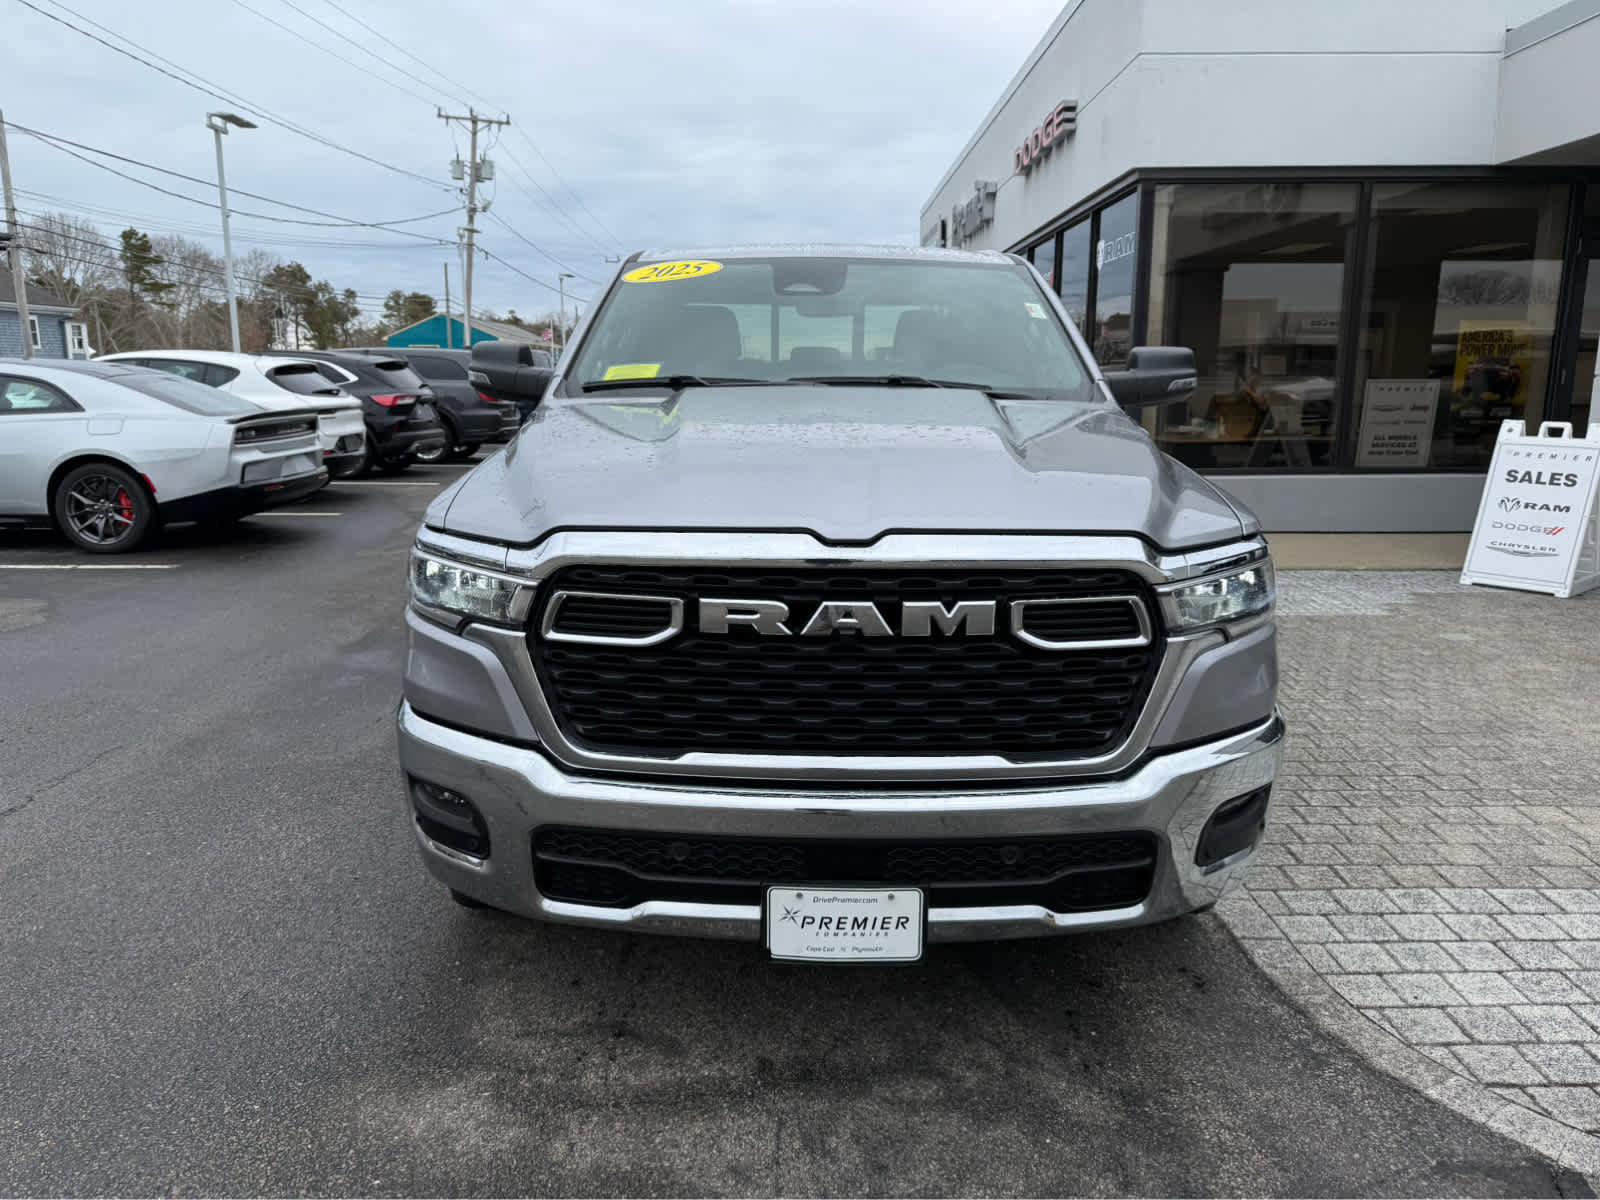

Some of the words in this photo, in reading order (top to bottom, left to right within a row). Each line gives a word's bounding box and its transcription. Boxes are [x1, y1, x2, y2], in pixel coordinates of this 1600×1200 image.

[1015, 102, 1074, 176] DODGE
[1104, 232, 1136, 263] RAM
[639, 264, 708, 280] 2025
[1513, 451, 1592, 462] PREMIER
[1505, 469, 1578, 487] SALES
[1523, 502, 1571, 513] RAM
[1492, 521, 1555, 535] DODGE
[1490, 540, 1557, 552] CHRYSLER
[699, 598, 997, 636] RAM
[813, 896, 878, 904] DrivePremier.com
[801, 916, 910, 930] PREMIER
